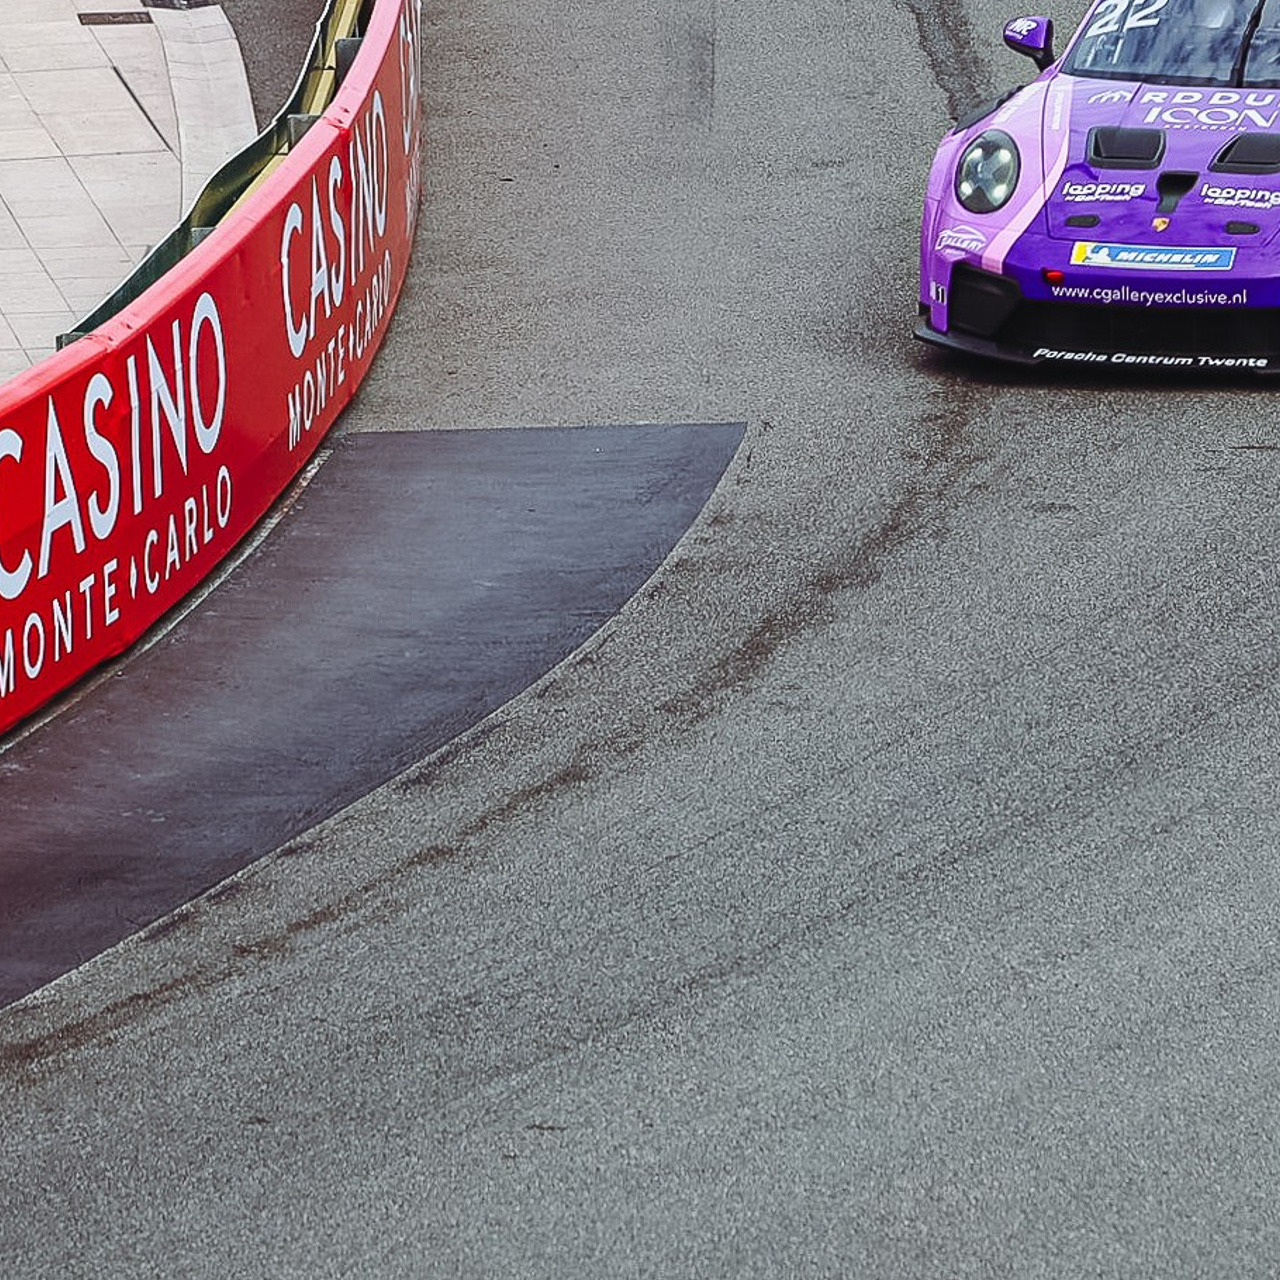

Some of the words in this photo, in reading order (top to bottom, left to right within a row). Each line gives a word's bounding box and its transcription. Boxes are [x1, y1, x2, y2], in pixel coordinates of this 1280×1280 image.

[1143, 107, 1279, 127] ICON
[1062, 182, 1146, 197] looping
[280, 89, 389, 358] CASINO
[1115, 251, 1221, 264] MICHELIN
[1051, 285, 1247, 307] www.cgalleryexclusive.nl
[1033, 348, 1107, 362] Porsche
[1111, 353, 1194, 366] Centrum
[1198, 356, 1269, 368] Twente
